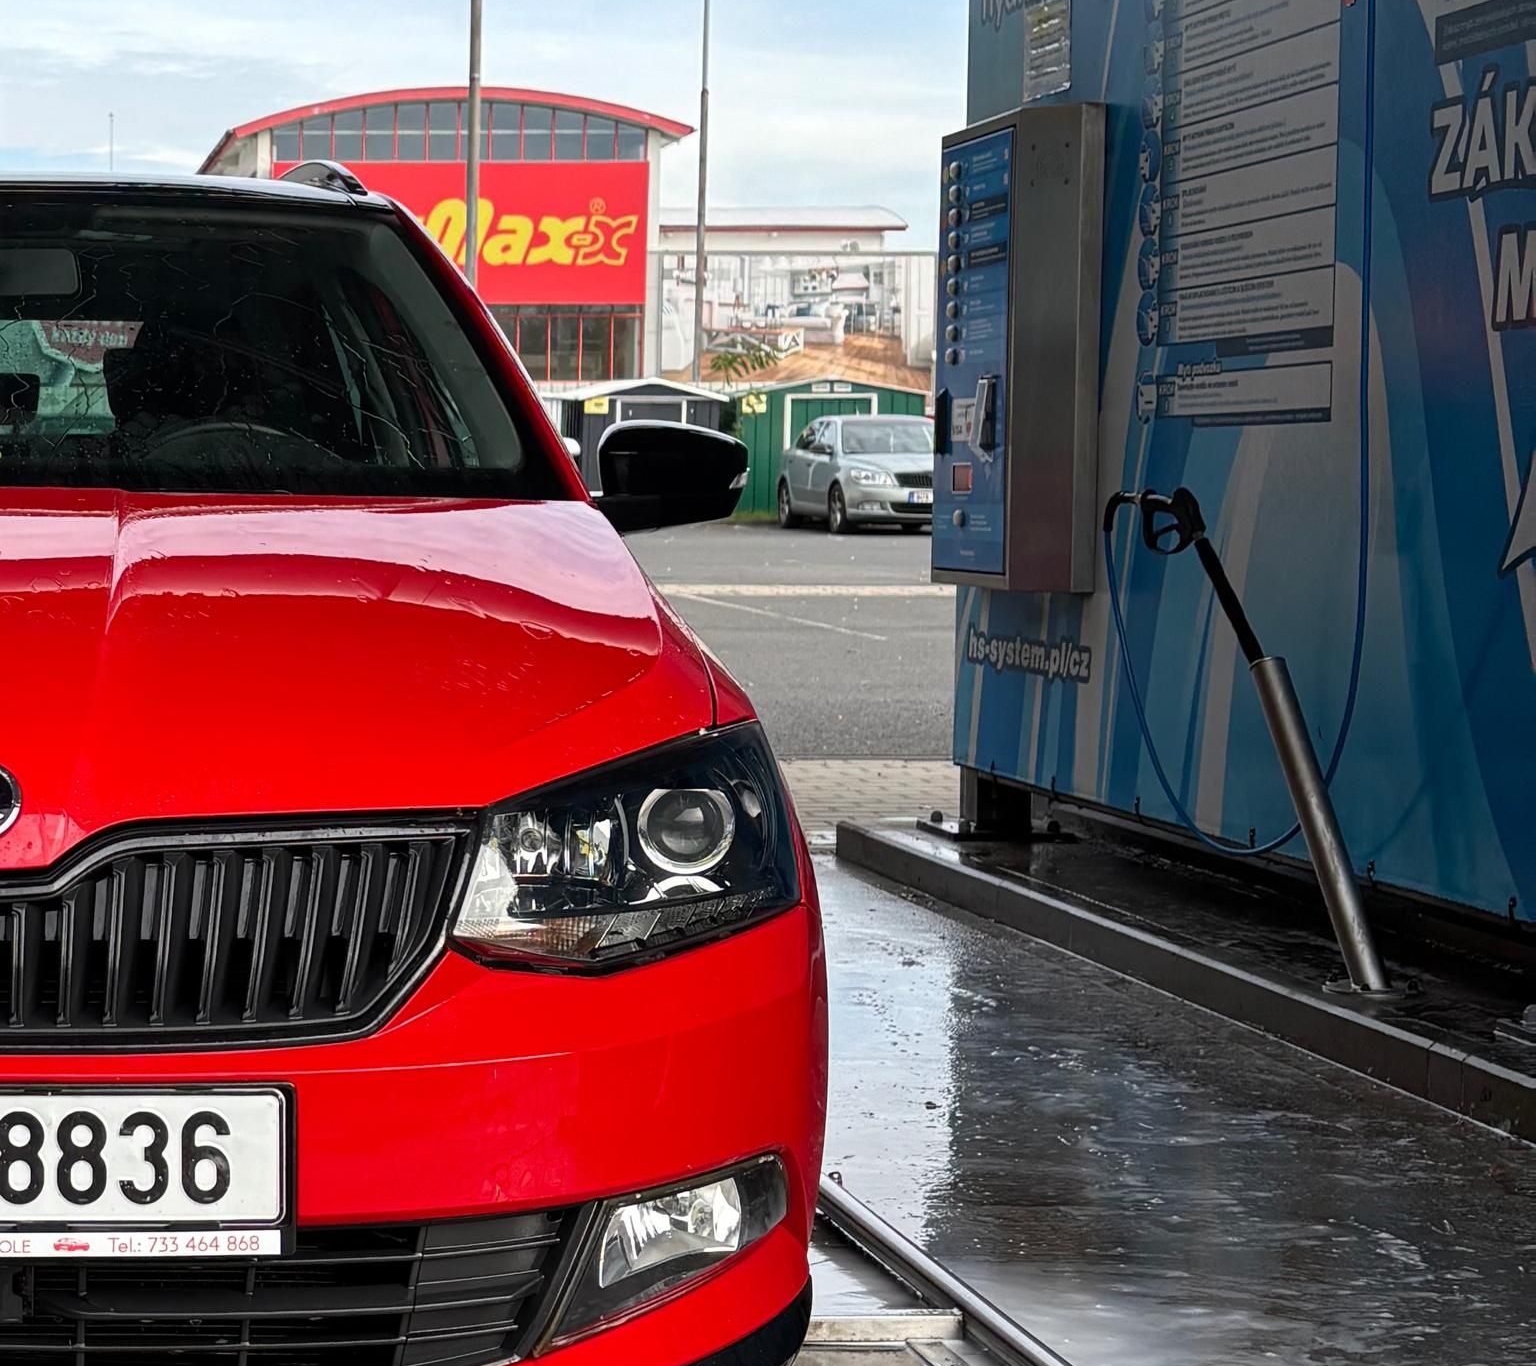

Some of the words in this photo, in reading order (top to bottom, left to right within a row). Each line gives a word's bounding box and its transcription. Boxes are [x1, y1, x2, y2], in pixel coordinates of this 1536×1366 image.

[968, 627, 1090, 679] hs-system.pl/cz
[107, 1237, 142, 1253] Tel.:
[148, 1237, 178, 1252] 733
[185, 1236, 220, 1252] 464
[227, 1235, 259, 1251] 868
